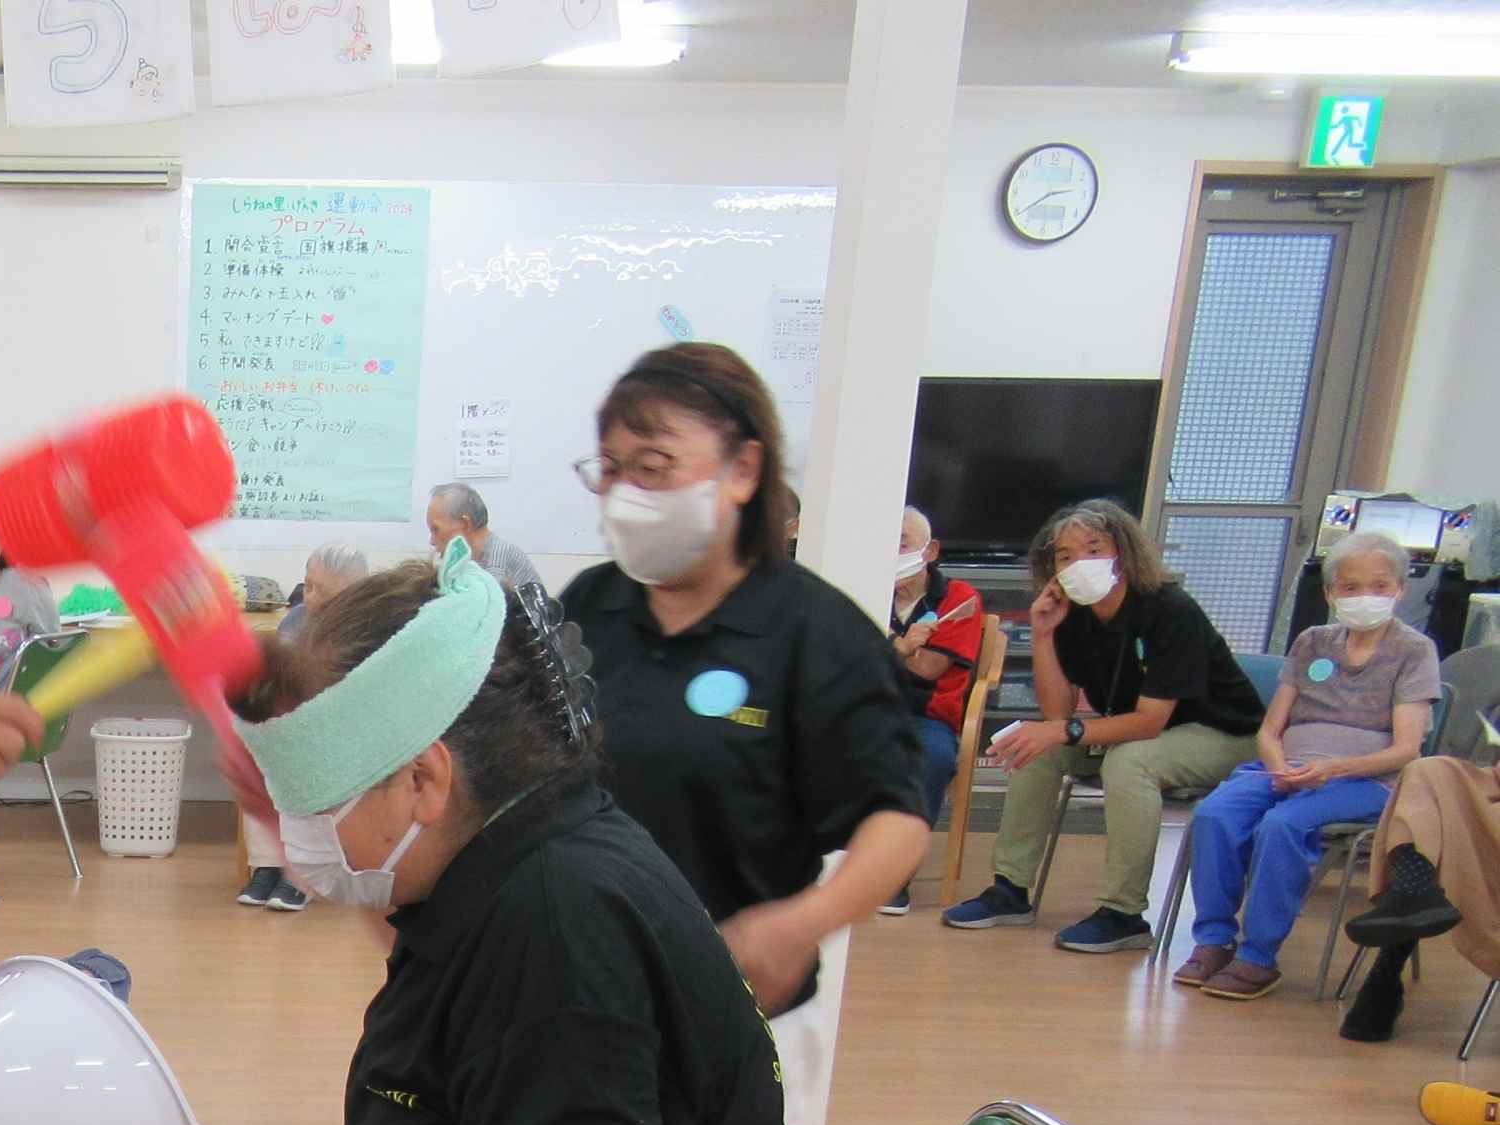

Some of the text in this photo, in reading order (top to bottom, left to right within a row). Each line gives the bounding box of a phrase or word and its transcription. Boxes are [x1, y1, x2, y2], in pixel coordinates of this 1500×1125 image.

[270, 214, 366, 236] プログラム
